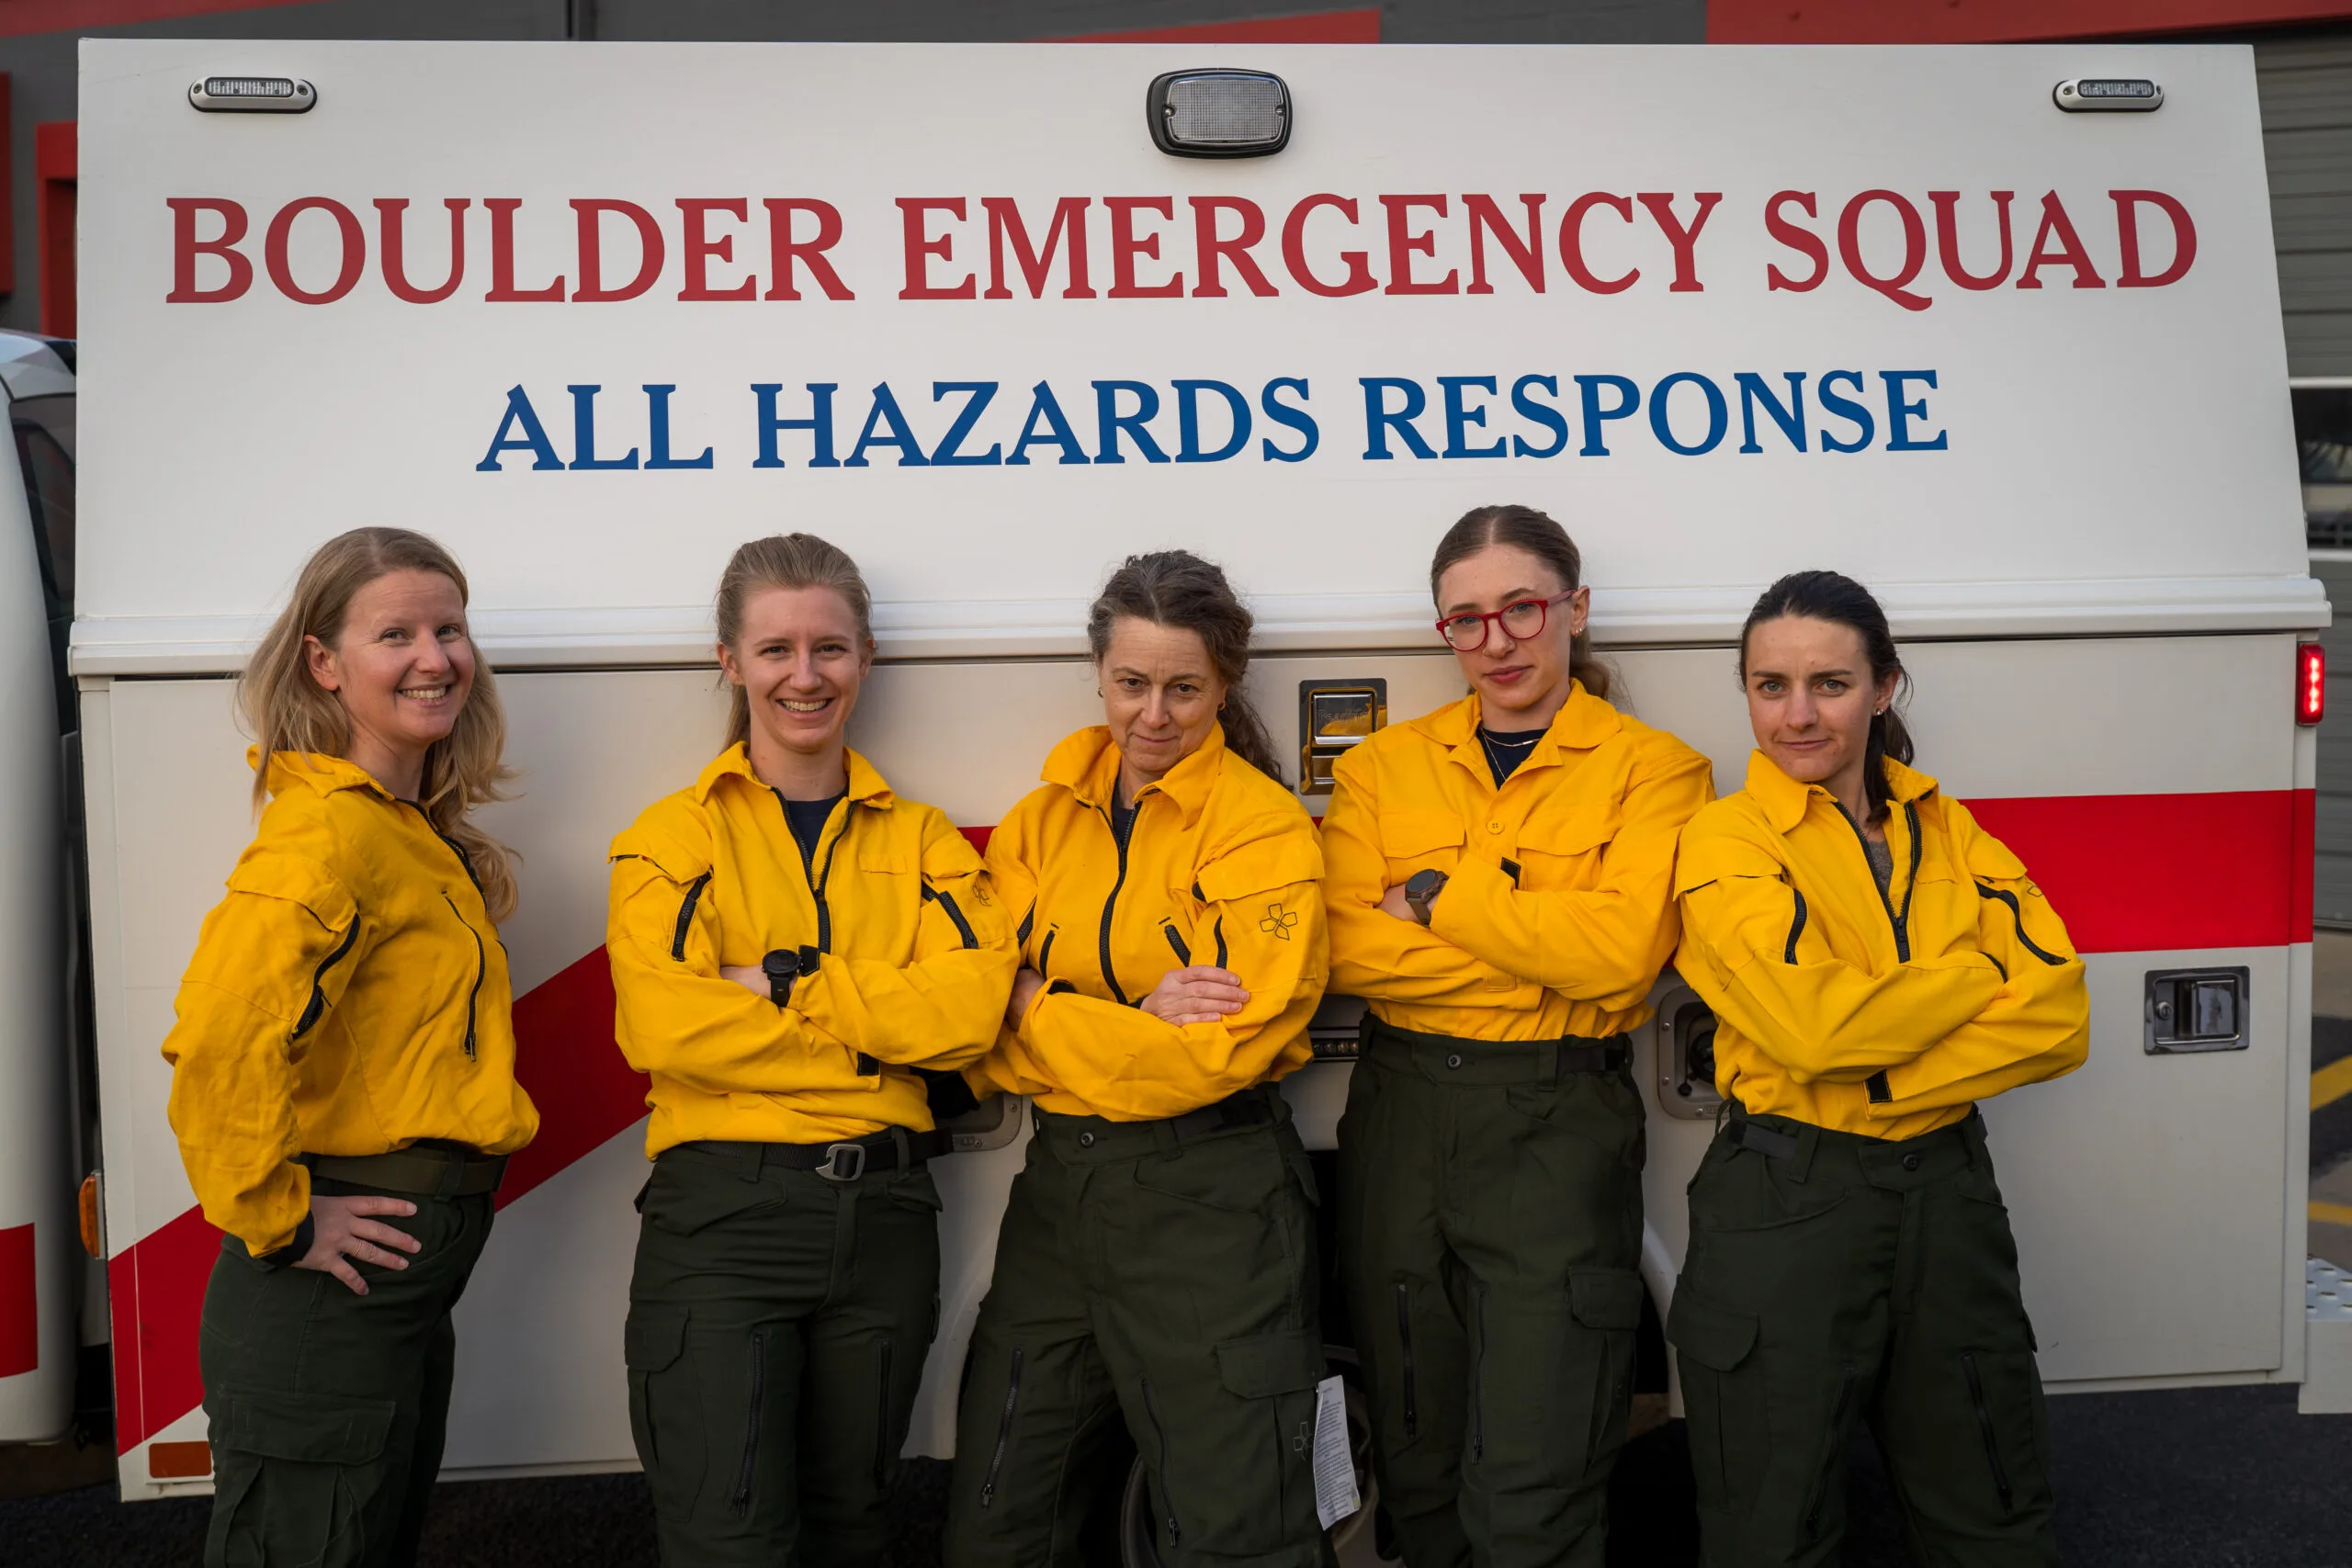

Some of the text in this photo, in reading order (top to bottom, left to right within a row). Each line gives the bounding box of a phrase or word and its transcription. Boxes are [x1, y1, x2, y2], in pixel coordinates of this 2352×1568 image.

[166, 189, 2197, 311] BOULDER EMERGENCY SQUAD
[476, 369, 1948, 472] ALL HAZARDS RESPONSE
